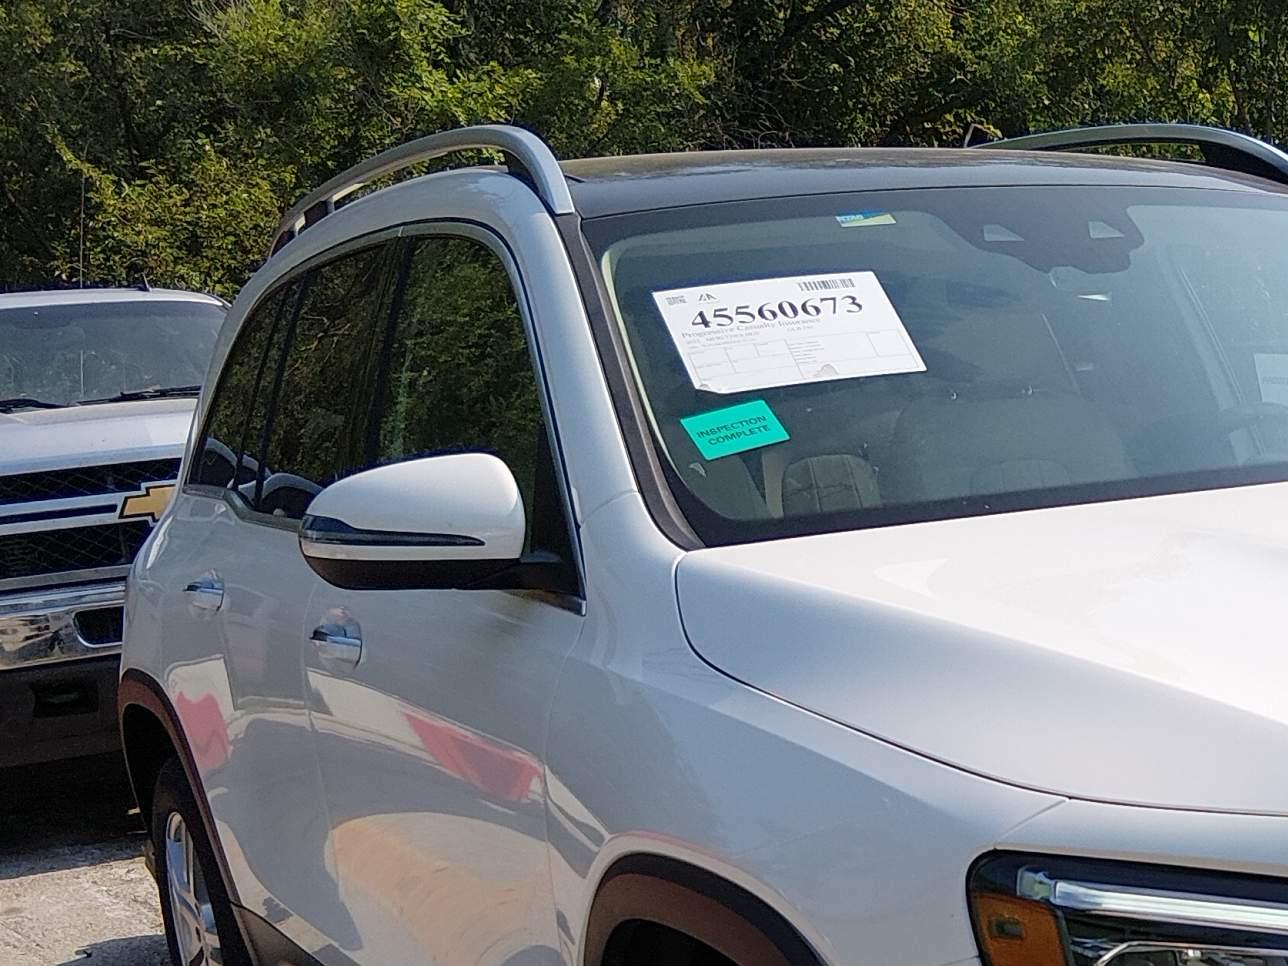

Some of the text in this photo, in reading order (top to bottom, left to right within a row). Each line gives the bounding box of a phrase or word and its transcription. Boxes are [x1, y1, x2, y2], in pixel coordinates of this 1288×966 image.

[692, 295, 863, 329] 45560673
[697, 416, 768, 438] INSPECTION
[707, 425, 770, 446] COMPLETE
